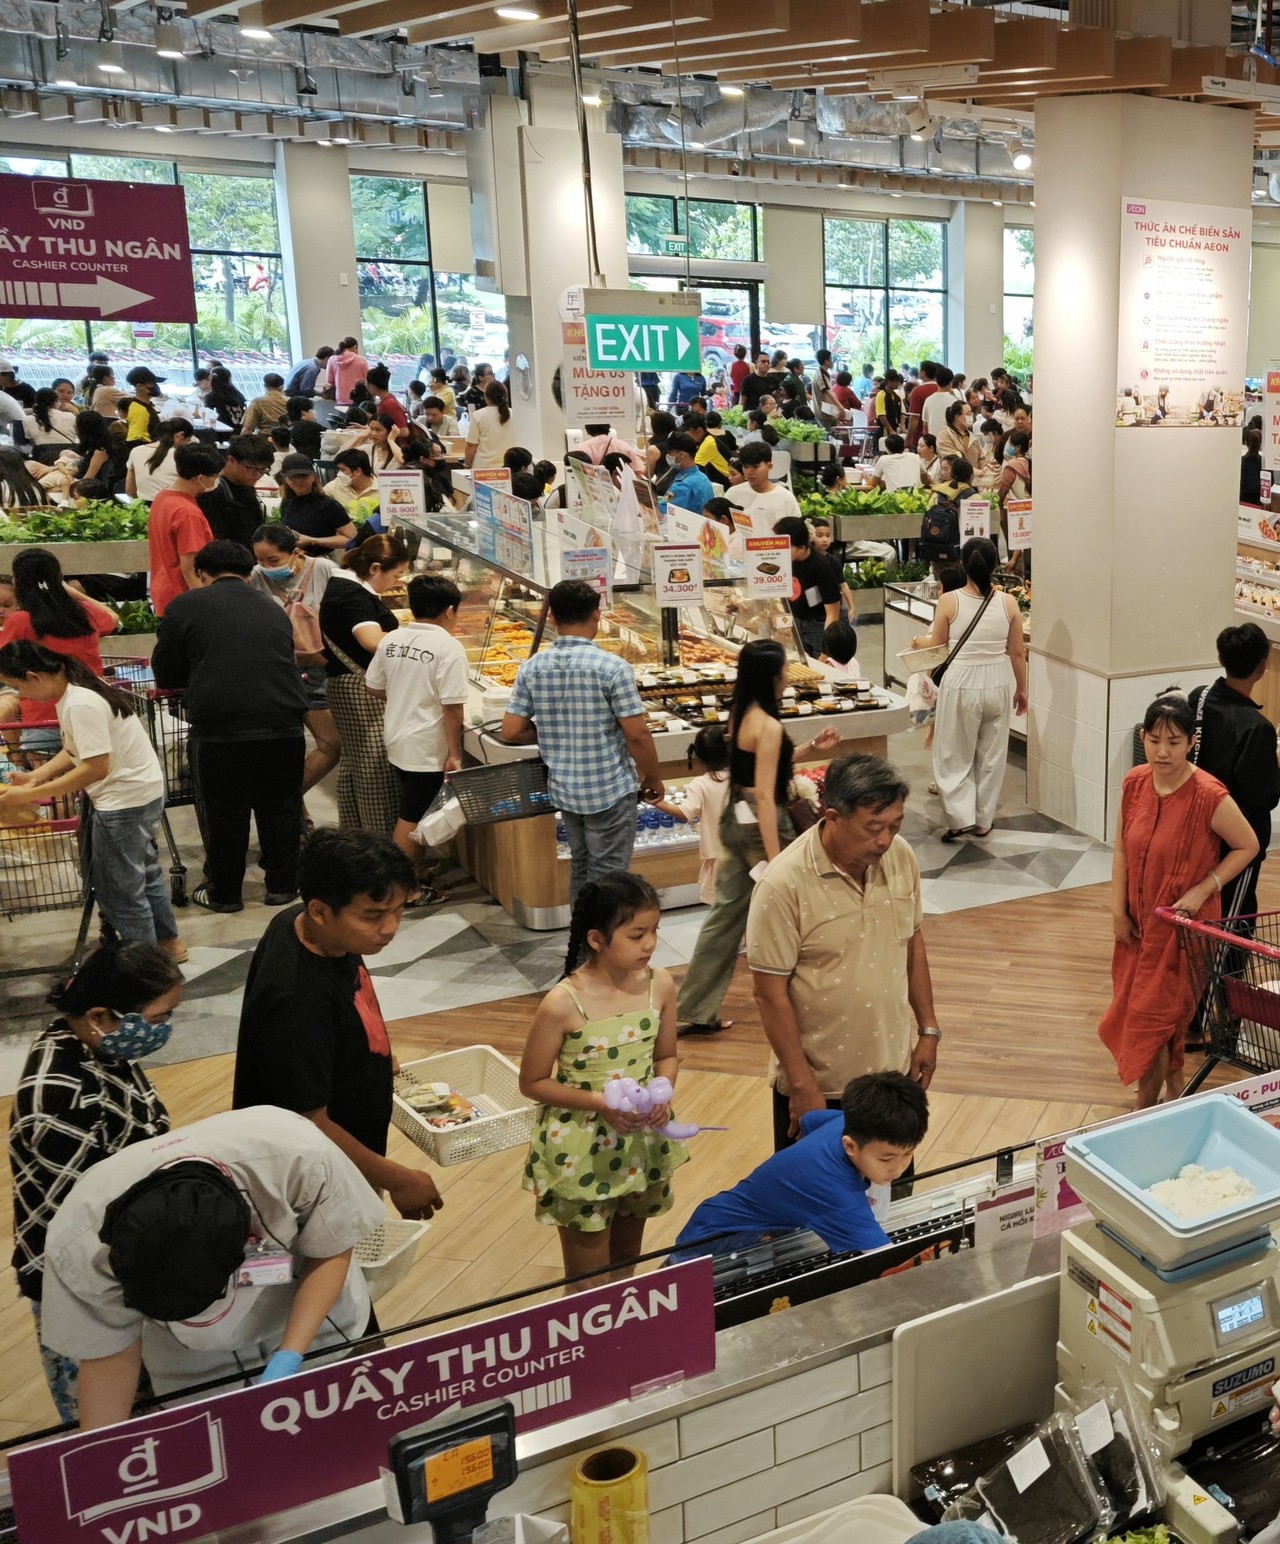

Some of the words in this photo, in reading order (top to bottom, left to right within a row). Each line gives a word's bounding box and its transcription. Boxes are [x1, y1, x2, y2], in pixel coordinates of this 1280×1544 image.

[47, 218, 85, 231] VND
[1200, 225, 1220, 237] BIẾN
[39, 237, 96, 256] THU
[105, 237, 181, 260] NGÂN
[669, 242, 685, 251] EXIT
[1145, 235, 1166, 247] TIÊU
[1204, 242, 1229, 252] AEON
[13, 259, 67, 270] CASHIER
[70, 261, 128, 273] COUNTER
[596, 324, 669, 361] EXIT
[573, 384, 609, 400] TẶNG
[612, 386, 626, 397] 01
[999, 1210, 1023, 1222] NIGIRI
[260, 1360, 416, 1435] QUẦY
[427, 1332, 532, 1382] THU
[546, 1282, 679, 1349] NGÂN
[376, 1379, 476, 1421] CASHIER
[482, 1345, 585, 1388] COUNTER
[1214, 1359, 1273, 1395] SUZUMO
[101, 1503, 202, 1544] VND
